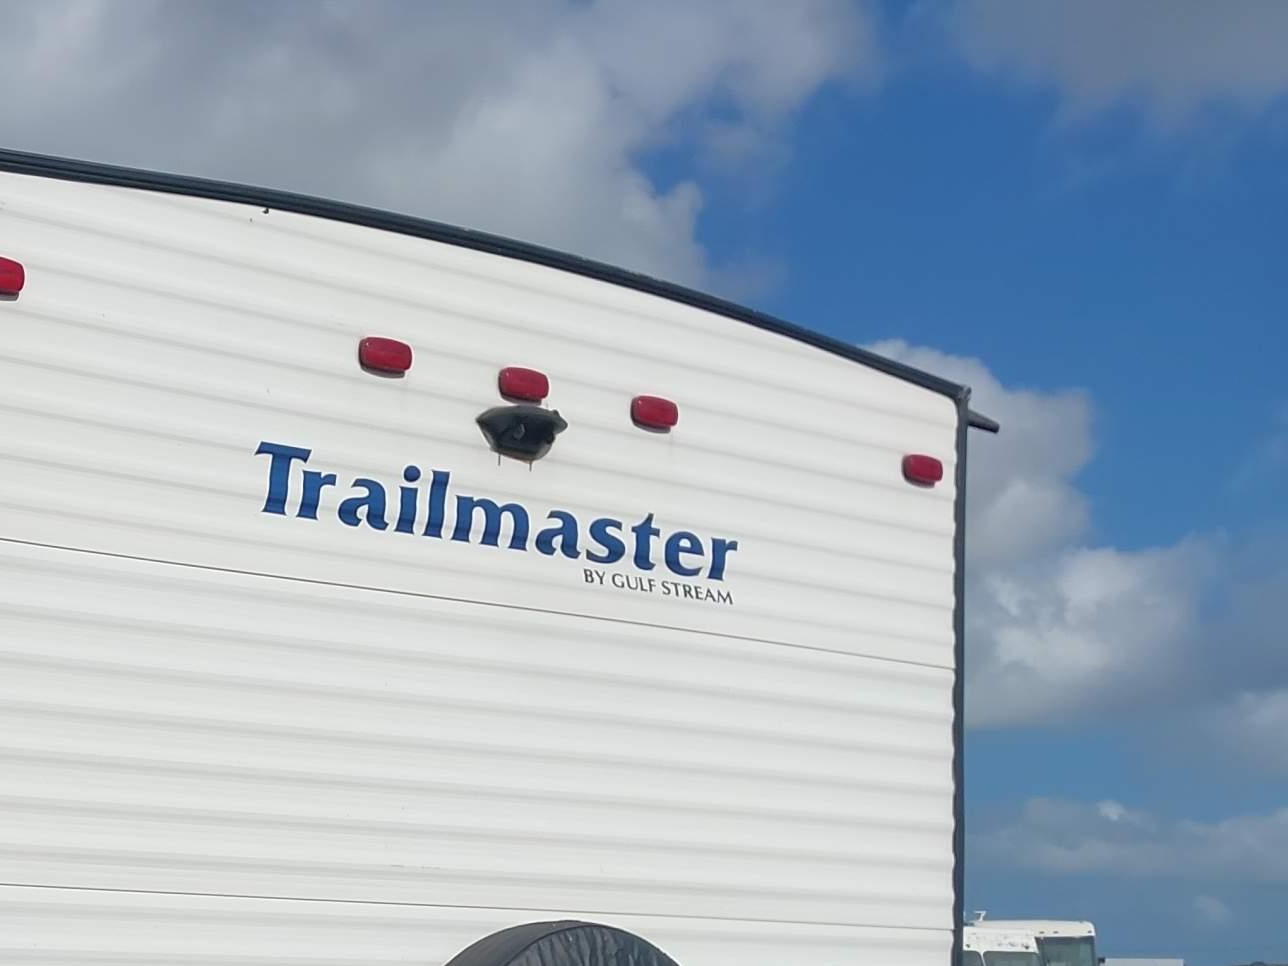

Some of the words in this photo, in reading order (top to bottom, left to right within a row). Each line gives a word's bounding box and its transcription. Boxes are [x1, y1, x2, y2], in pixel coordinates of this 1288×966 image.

[255, 441, 738, 581] Trailmaster
[583, 568, 605, 584] BY
[612, 572, 656, 593] GULF
[661, 580, 734, 605] STREAM
